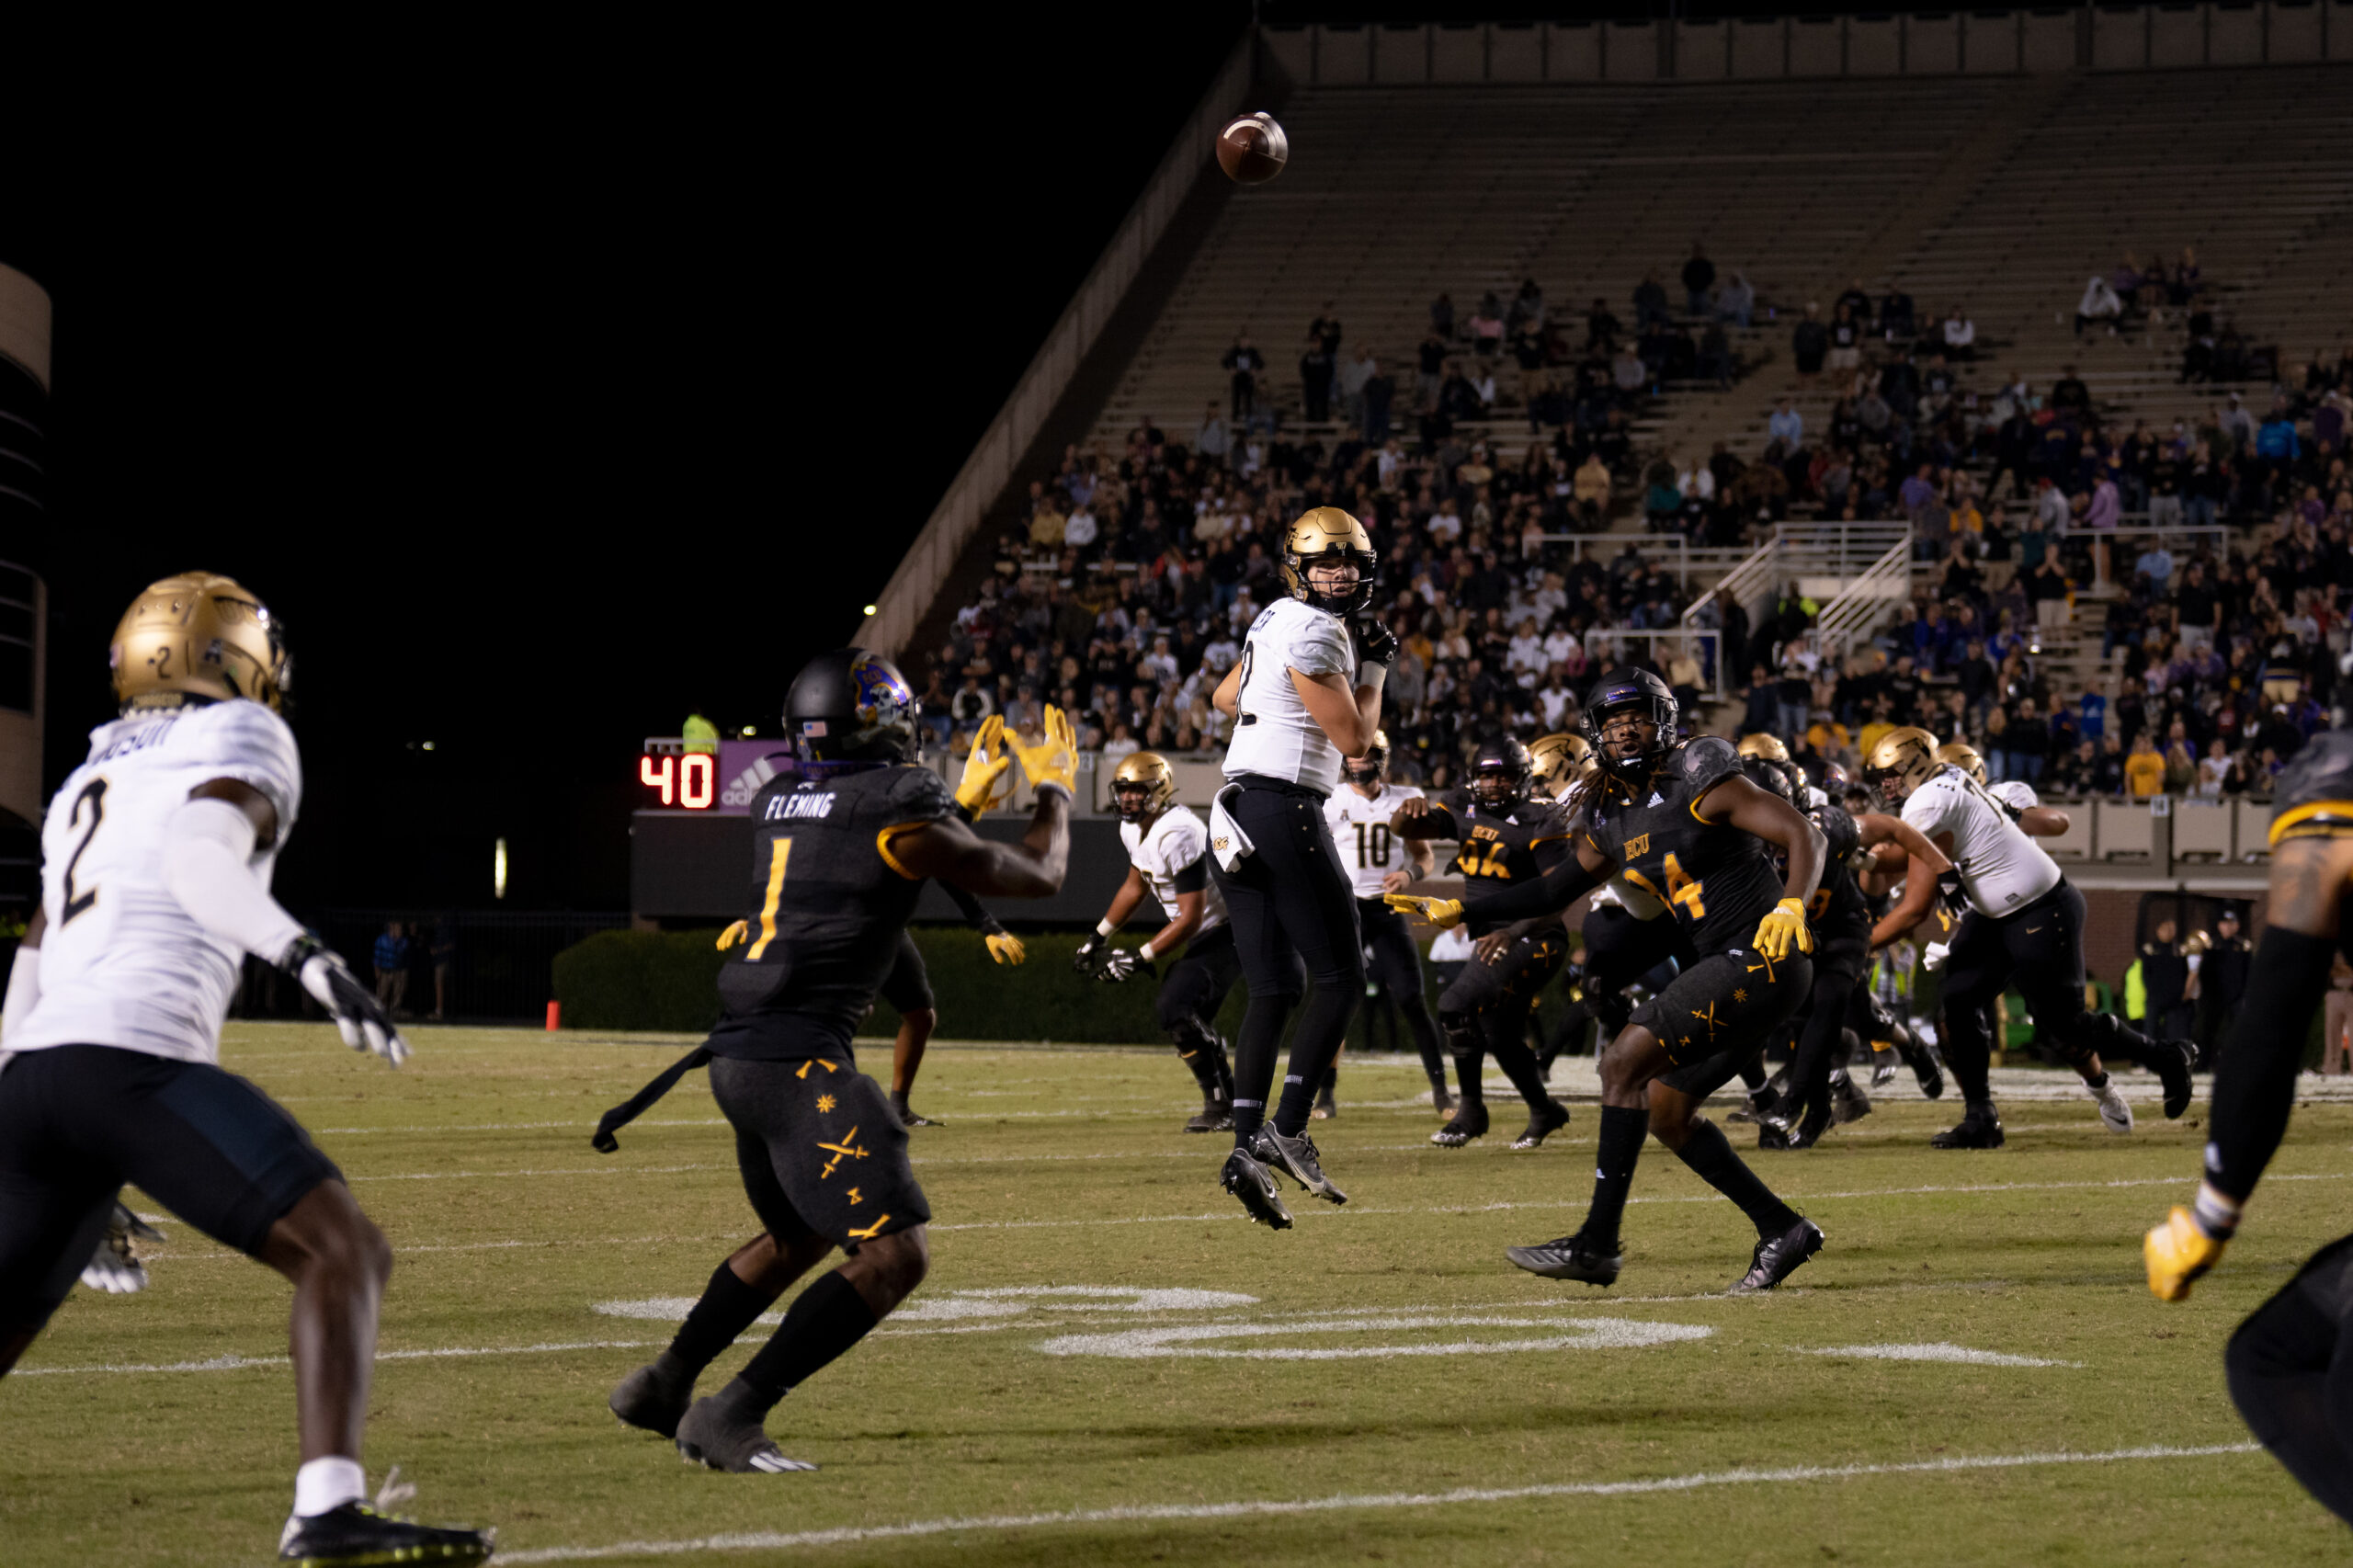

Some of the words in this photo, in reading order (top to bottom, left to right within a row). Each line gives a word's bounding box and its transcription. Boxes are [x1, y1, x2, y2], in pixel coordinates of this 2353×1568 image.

[641, 754, 713, 809] 40
[765, 791, 837, 821] FLEMING
[61, 778, 108, 927] 2
[1351, 822, 1390, 869] 10
[1472, 824, 1500, 843] ECU
[1622, 832, 1650, 862] ECU
[744, 835, 794, 963] 1
